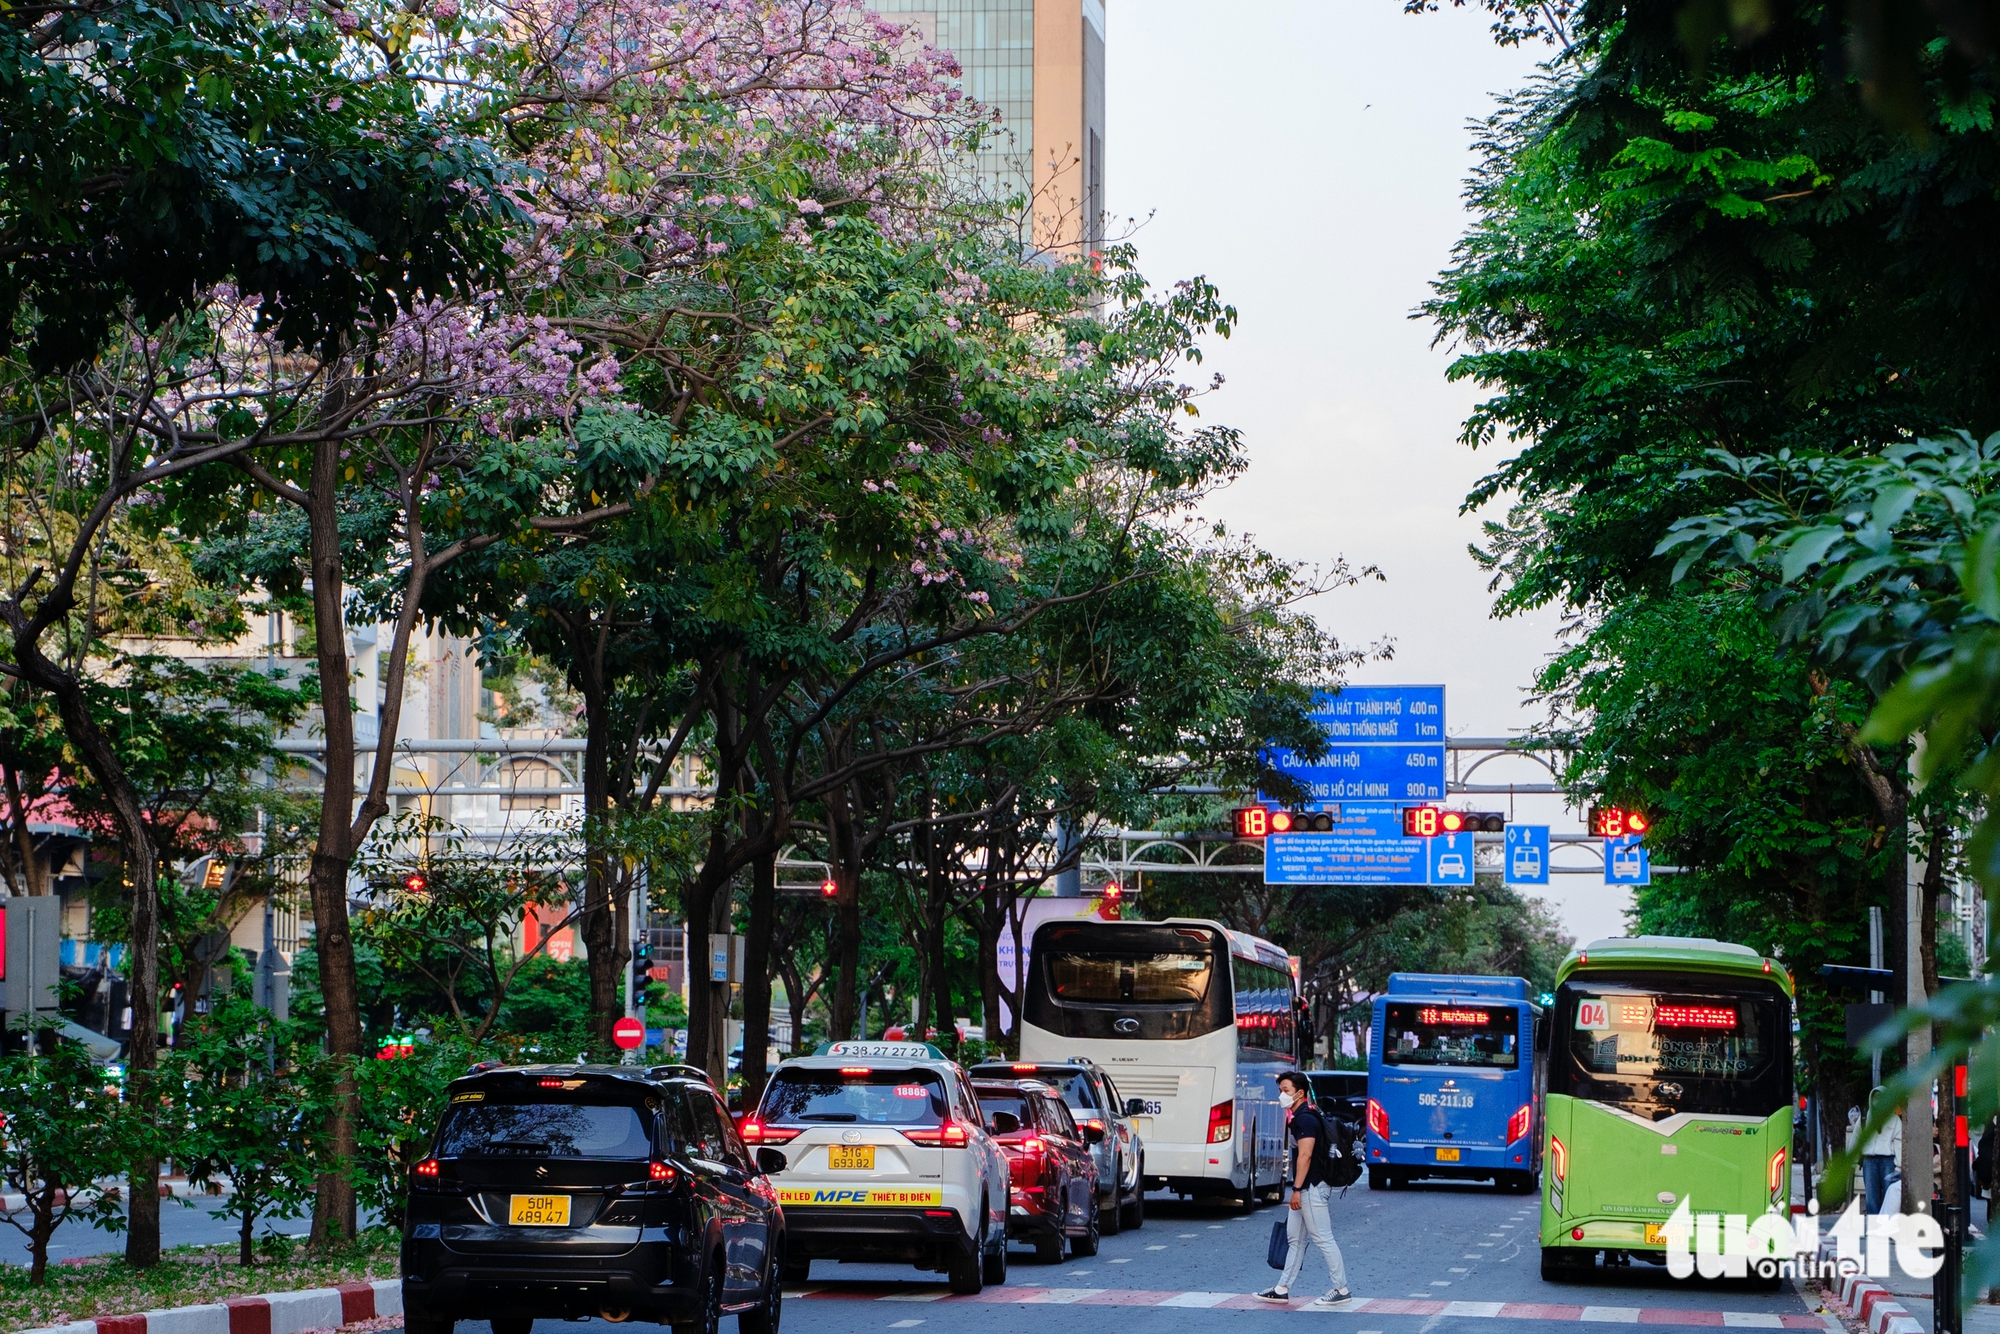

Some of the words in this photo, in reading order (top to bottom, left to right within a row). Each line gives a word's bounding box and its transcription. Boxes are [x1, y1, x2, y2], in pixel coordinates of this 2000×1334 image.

[1336, 698, 1352, 715] HÁT
[1355, 698, 1383, 715] THÀNH
[1385, 697, 1402, 715] PHỐ
[1409, 701, 1427, 715] 400
[1428, 704, 1438, 715] m
[1351, 718, 1377, 736] THỐNG
[1378, 718, 1398, 736] NHẤT
[1415, 722, 1420, 736] 1
[1422, 722, 1437, 736] km
[1343, 750, 1360, 770] HỘI
[1406, 753, 1426, 767] 450
[1427, 756, 1438, 767] m
[1306, 780, 1329, 797] ÀNG
[1331, 778, 1345, 797] HỒ
[1346, 780, 1363, 797] CHÍ
[1364, 783, 1389, 797] MINH
[1407, 782, 1426, 797] 900
[1428, 786, 1438, 797] m
[1244, 809, 1266, 835] 18
[1414, 809, 1437, 835] 18
[550, 941, 571, 949] OPEN
[1581, 1004, 1605, 1025] 04
[852, 1046, 888, 1056] 38.27
[891, 1047, 907, 1056] 27
[910, 1048, 926, 1057] 27
[1692, 1057, 1746, 1071] TRANG
[896, 1087, 926, 1097] 18865
[1418, 1093, 1474, 1108] 50E-211.18
[842, 1147, 861, 1158] 51G
[833, 1158, 869, 1168] 693.82
[779, 1190, 792, 1201] ÈN
[794, 1193, 810, 1201] LED
[813, 1190, 869, 1202] MPE
[872, 1189, 896, 1201] THIẾT
[899, 1193, 908, 1203] BỊ
[910, 1192, 931, 1203] ĐIỆN
[527, 1198, 553, 1210] 50H
[516, 1211, 563, 1223] 489.47
